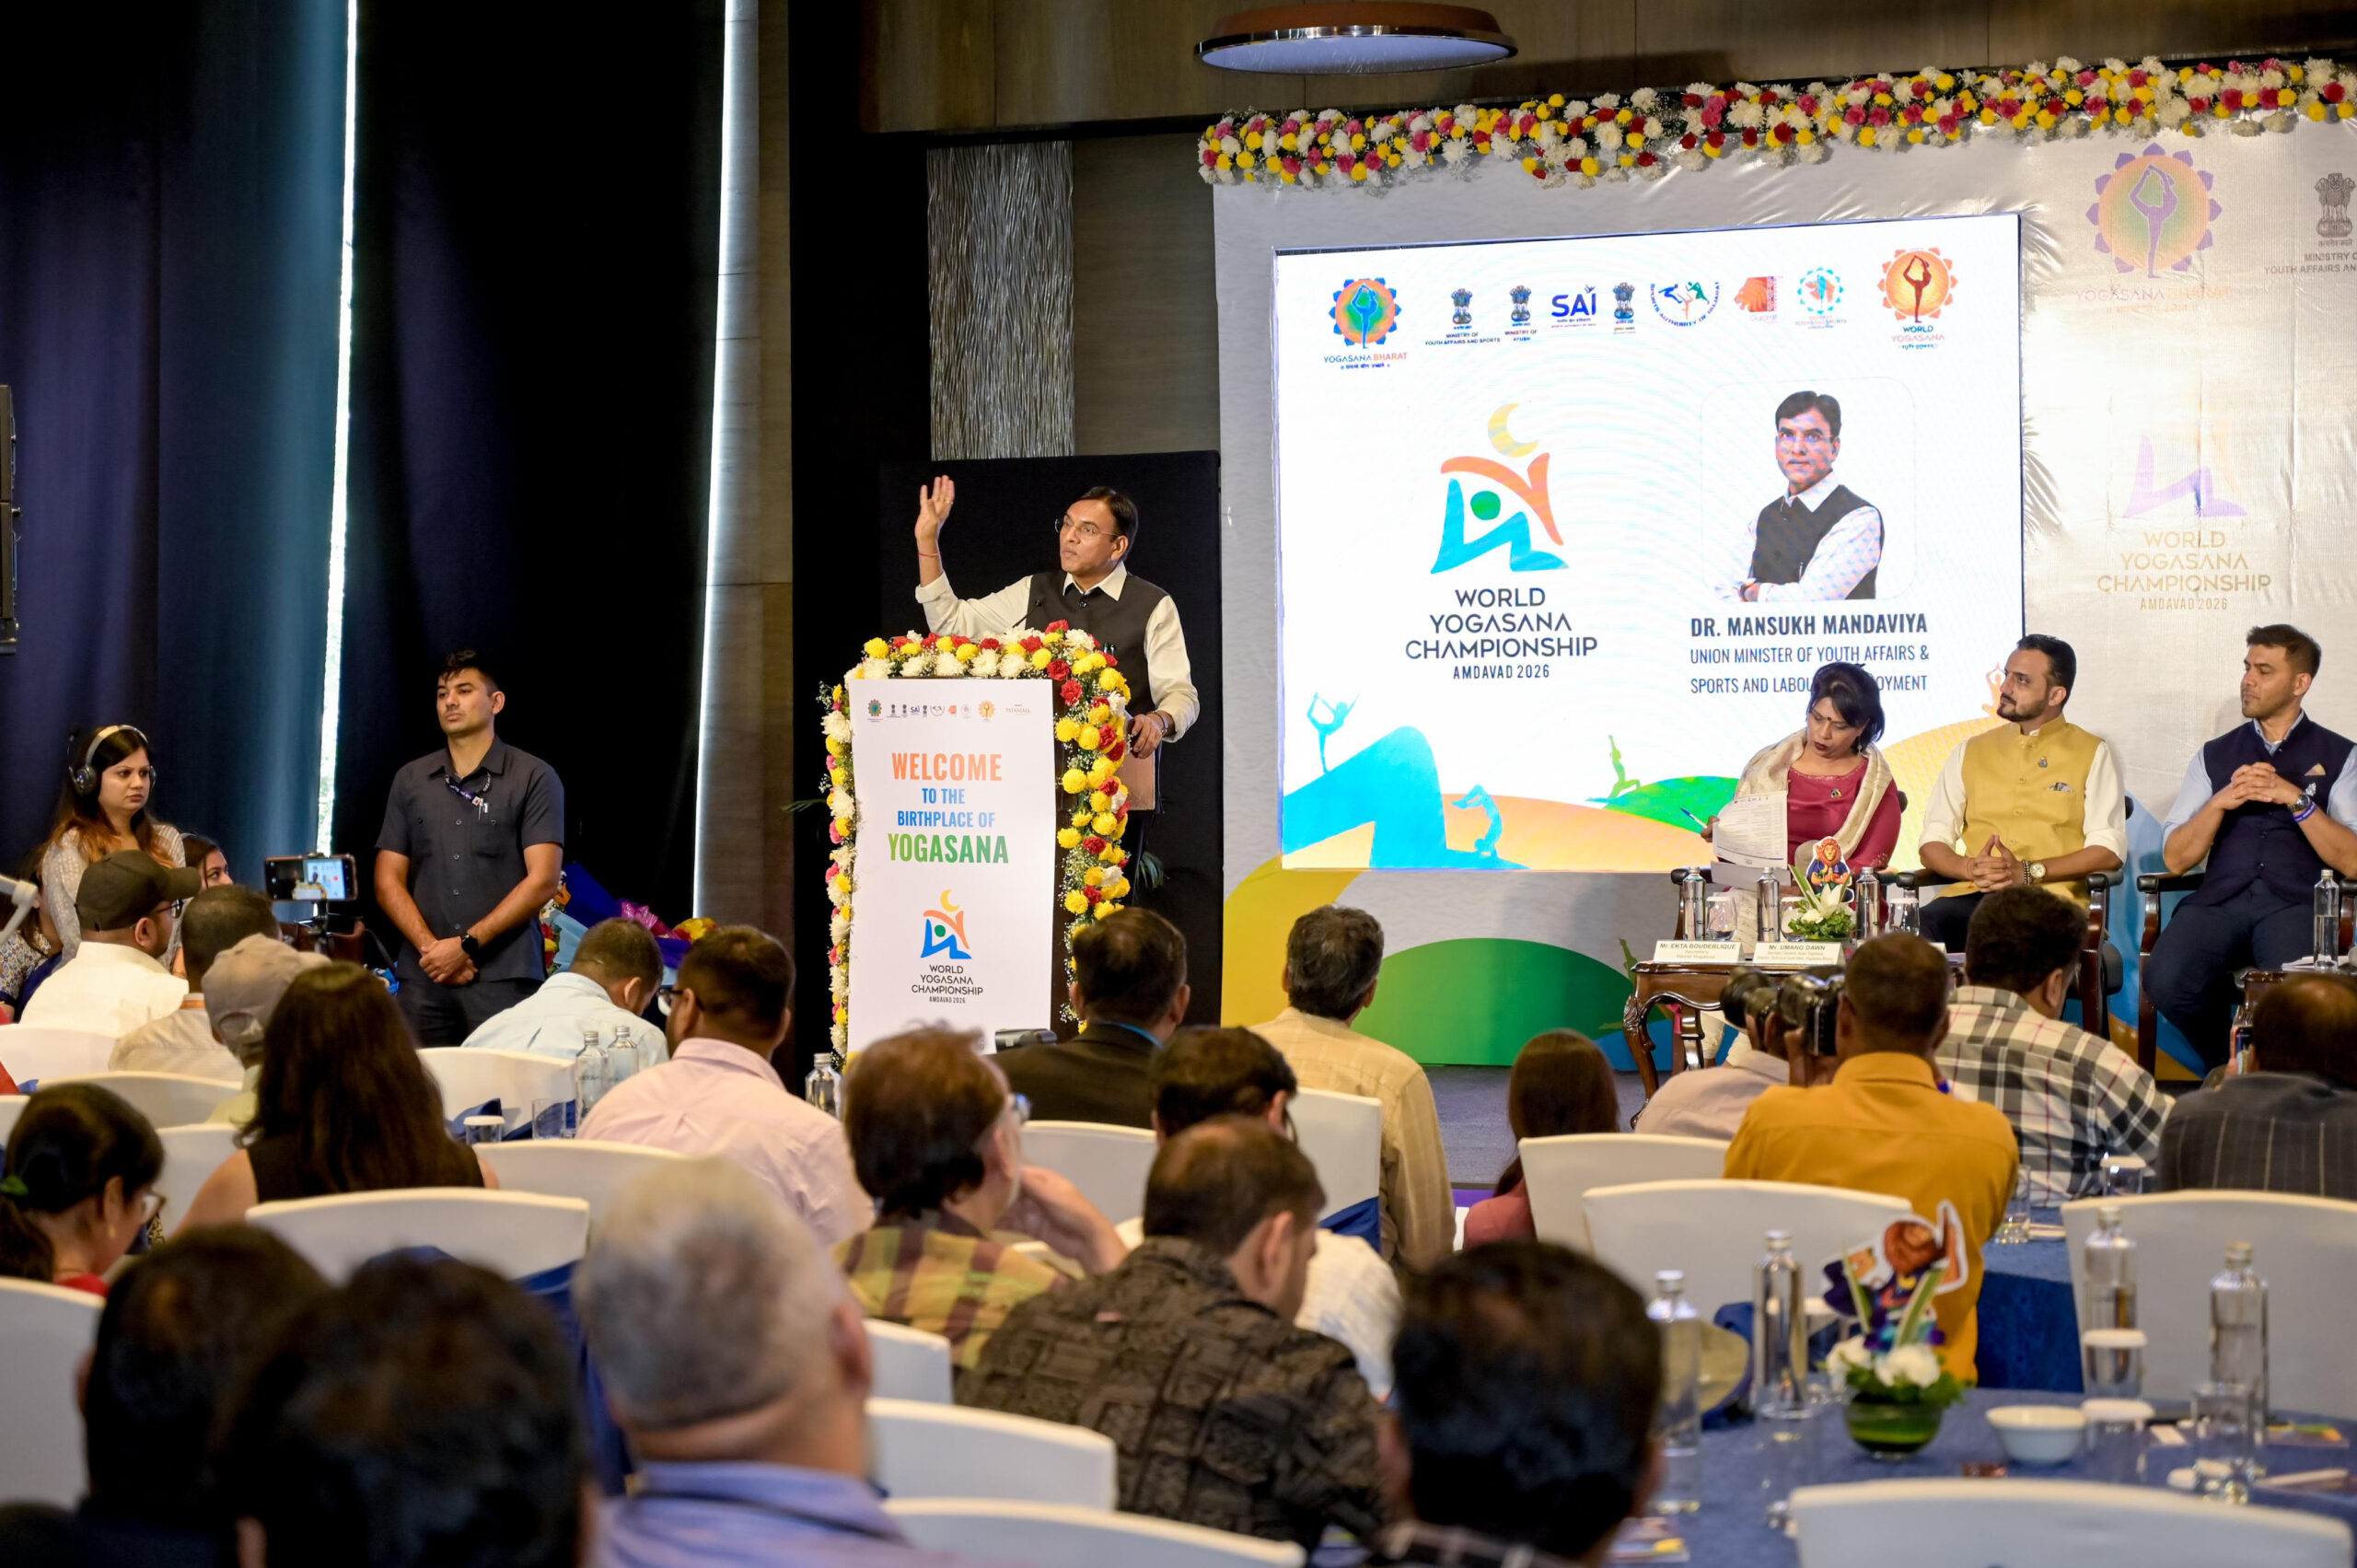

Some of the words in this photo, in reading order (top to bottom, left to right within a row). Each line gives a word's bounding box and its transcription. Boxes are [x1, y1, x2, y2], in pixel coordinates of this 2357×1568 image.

[2305, 252, 2350, 261] MINISTRY
[2264, 265, 2297, 274] YOUTH
[2299, 264, 2340, 273] AFFAIRS
[2343, 264, 2357, 273] AN
[2074, 287, 2165, 302] YOGASANA
[1551, 292, 1596, 317] SAI
[1891, 333, 1945, 343] YOGASANA
[1324, 354, 1372, 363] YOGASANA
[1374, 353, 1408, 361] BHARAT
[2144, 530, 2226, 548] WORLD
[2121, 553, 2249, 570] YOGASANA
[2097, 575, 2272, 592] CHAMPIONSHIP
[1455, 587, 1546, 608] WORLD
[2140, 598, 2195, 610] AMDAVAD
[2198, 598, 2228, 610] 2026
[1430, 612, 1572, 633] YOGASANA
[1690, 618, 1721, 637] DR.
[1727, 615, 1816, 636] MANSUKH
[1823, 613, 1928, 634] MANDAVIYA
[1405, 636, 1598, 659] CHAMPIONSHIP
[1690, 648, 1730, 664] UNION
[1734, 647, 1793, 663] MINISTER
[1796, 647, 1813, 662] OF
[1817, 645, 1860, 662] YOUTH
[1864, 645, 1916, 661] AFFAIRS
[1920, 645, 1930, 660] &
[1453, 665, 1513, 679] AMDAVAD
[1516, 664, 1550, 679] 2026
[1690, 678, 1739, 693] SPORTS
[1743, 678, 1769, 693] AND
[1773, 677, 1814, 693] LABOU
[891, 752, 1003, 782] WELCOME
[922, 788, 937, 804] TO
[941, 788, 965, 805] THE
[898, 810, 973, 828] BIRTHPLACE
[978, 812, 995, 828] OF
[888, 833, 1009, 864] YOGASANA
[929, 965, 964, 974] WORLD
[920, 974, 974, 985] YOGASANA
[911, 984, 984, 995] CHAMPIONSHIP
